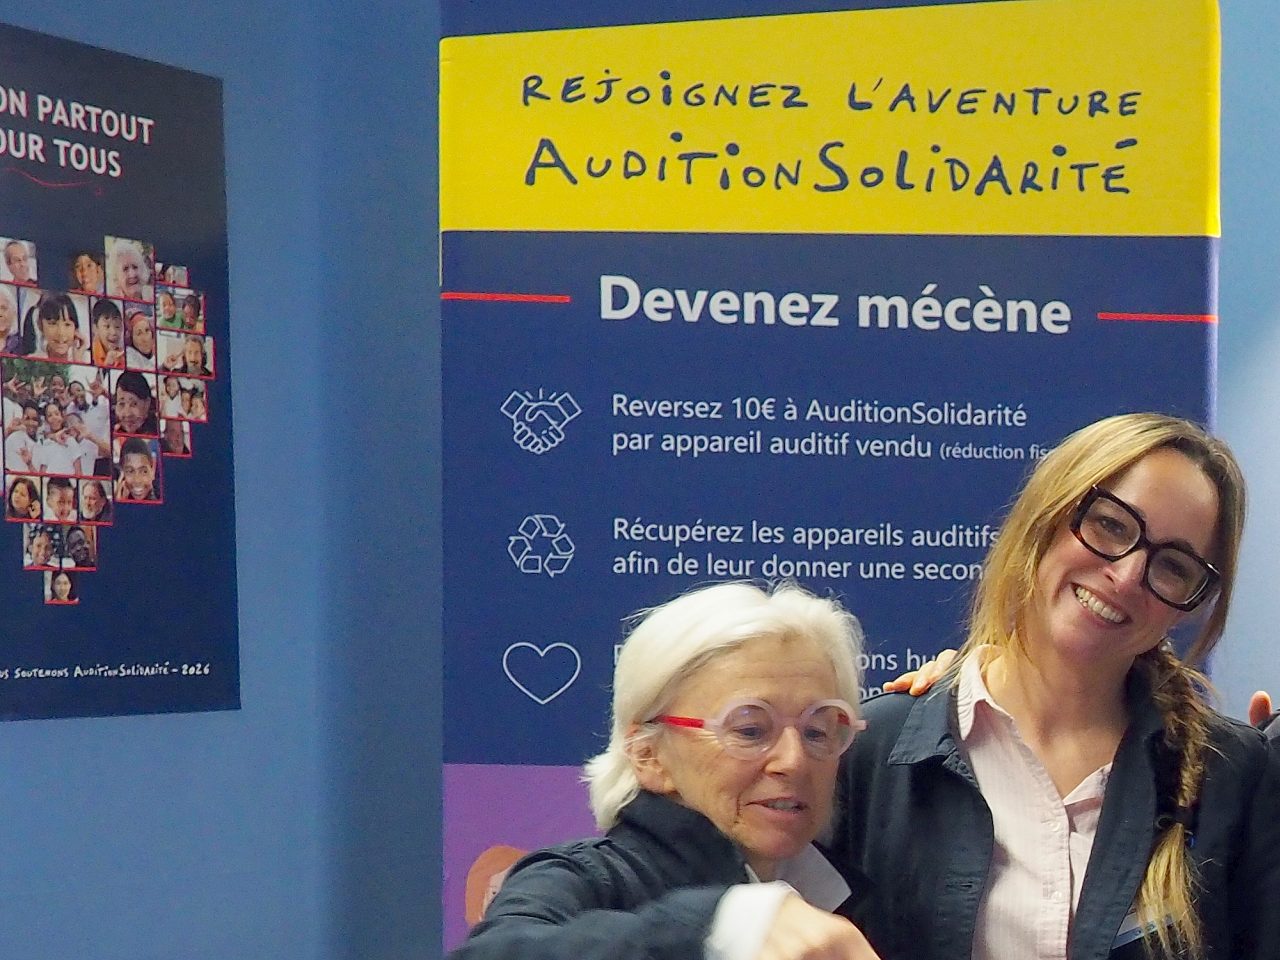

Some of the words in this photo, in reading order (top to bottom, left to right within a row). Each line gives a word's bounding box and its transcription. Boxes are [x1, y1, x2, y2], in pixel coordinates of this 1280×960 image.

[848, 78, 1142, 117] L'AVENTURE
[37, 94, 155, 144] PARTOUT
[53, 138, 122, 178] TOUS
[600, 275, 840, 327] Devenez
[858, 285, 1072, 334] mécène
[612, 393, 722, 420] Reversez
[731, 397, 776, 421] 10€
[784, 398, 798, 421] à
[806, 399, 1027, 427] AuditionSolidarité
[612, 434, 654, 456] par
[661, 431, 762, 457] appareil
[769, 432, 850, 456] auditif
[856, 434, 932, 458] vendu
[939, 441, 1024, 461] (réduction
[613, 517, 743, 546] Récupérez
[751, 520, 785, 545] les
[792, 522, 904, 551] appareils
[911, 523, 1000, 549] auditifs
[612, 551, 659, 576] afin
[667, 552, 699, 576] de
[707, 553, 755, 577] leur
[762, 554, 852, 579] donner
[859, 560, 905, 580] une
[181, 663, 210, 675] 2026
